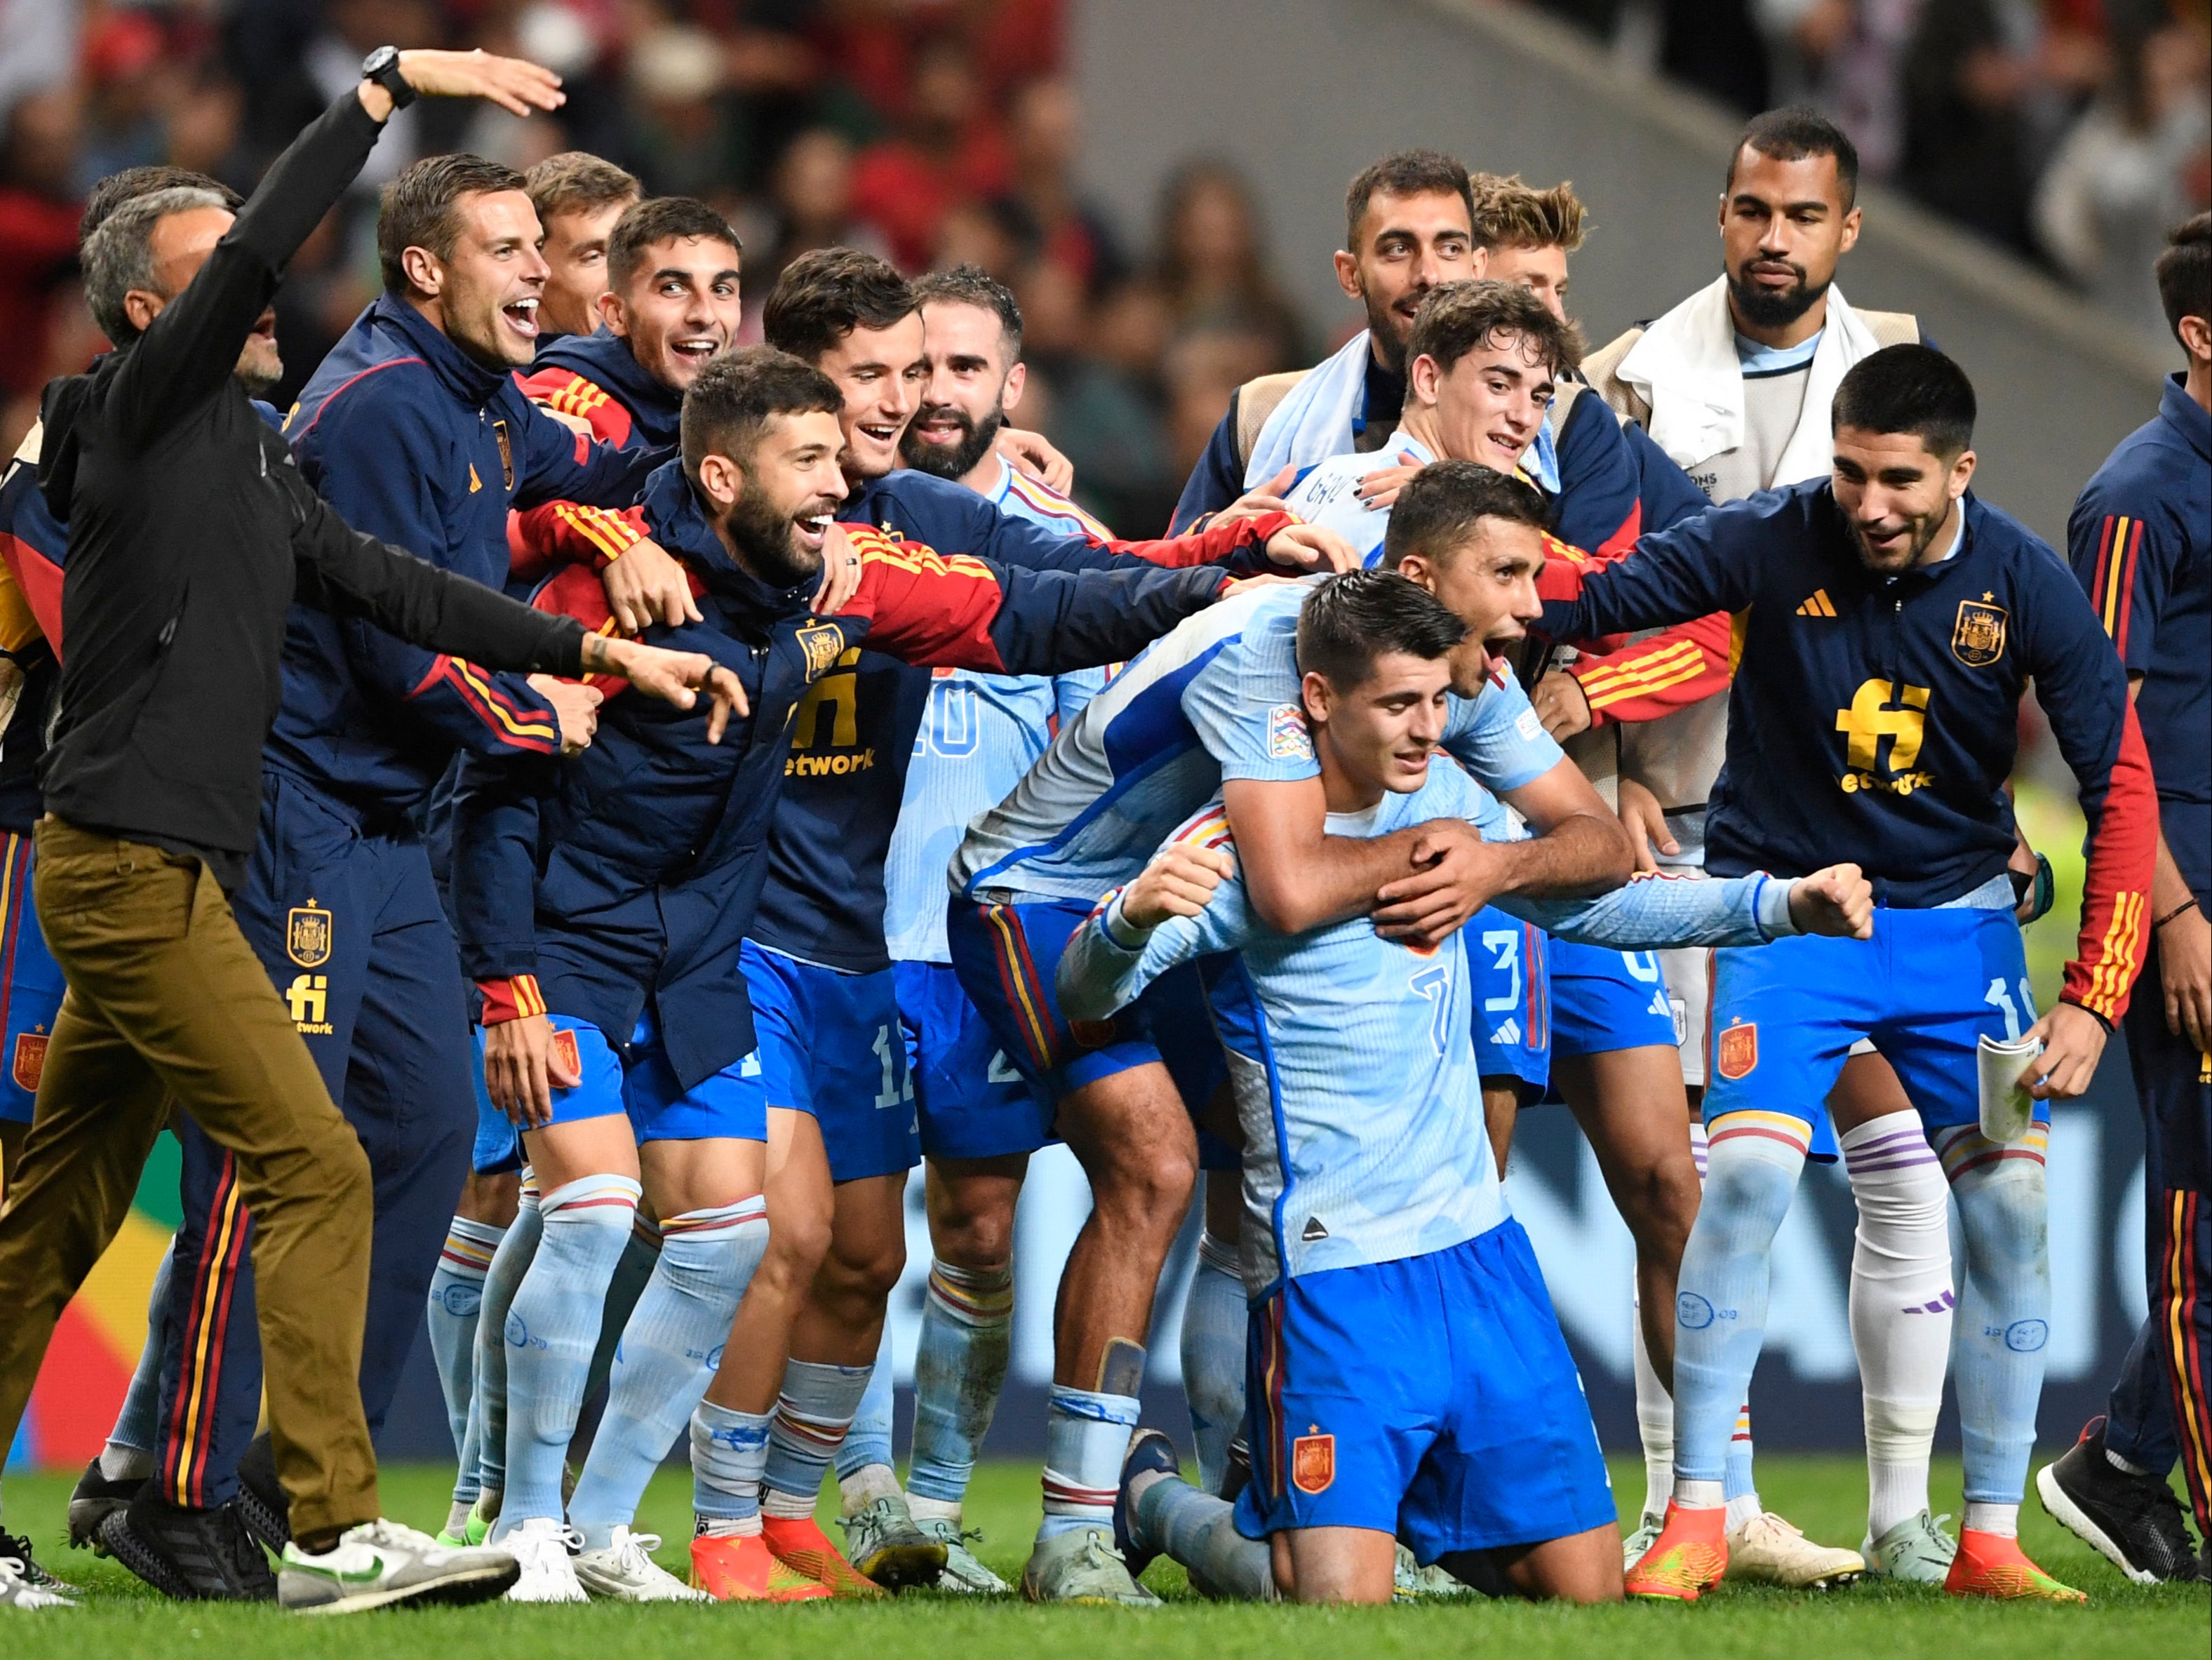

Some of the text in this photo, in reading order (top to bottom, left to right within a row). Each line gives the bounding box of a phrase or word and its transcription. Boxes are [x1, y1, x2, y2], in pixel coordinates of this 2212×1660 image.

[784, 748, 876, 777] etwork
[286, 974, 328, 1023] fi
[1408, 964, 1450, 1058] 7
[296, 1021, 334, 1035] twork
